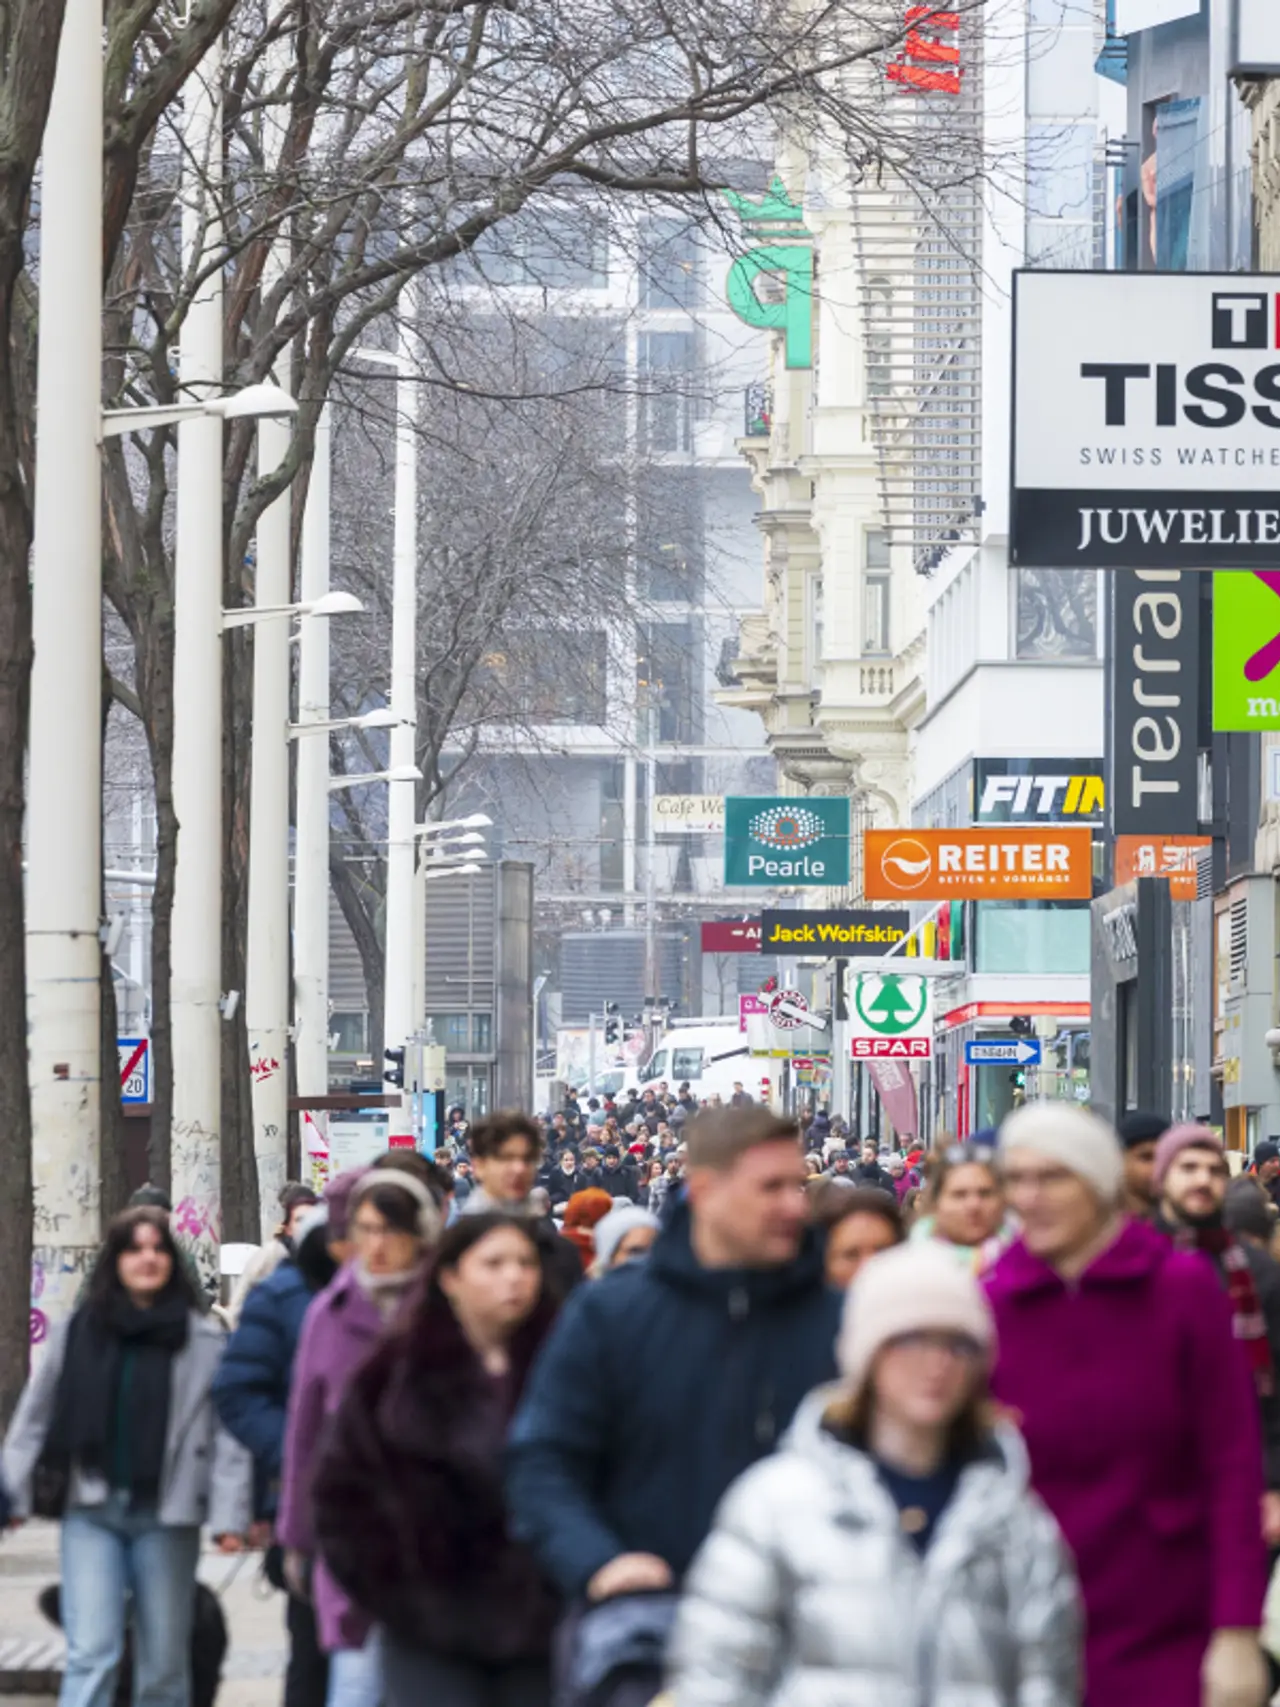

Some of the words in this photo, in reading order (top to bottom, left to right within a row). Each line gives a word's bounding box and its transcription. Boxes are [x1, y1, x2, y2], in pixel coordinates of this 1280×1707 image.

[1080, 447, 1163, 466] SWISS
[748, 855, 826, 877] Pearle
[938, 844, 1071, 871] REITER
[769, 923, 815, 943] Jack
[816, 923, 904, 943] Wolfskin
[854, 1040, 929, 1055] SPAR
[126, 1078, 142, 1094] 20
